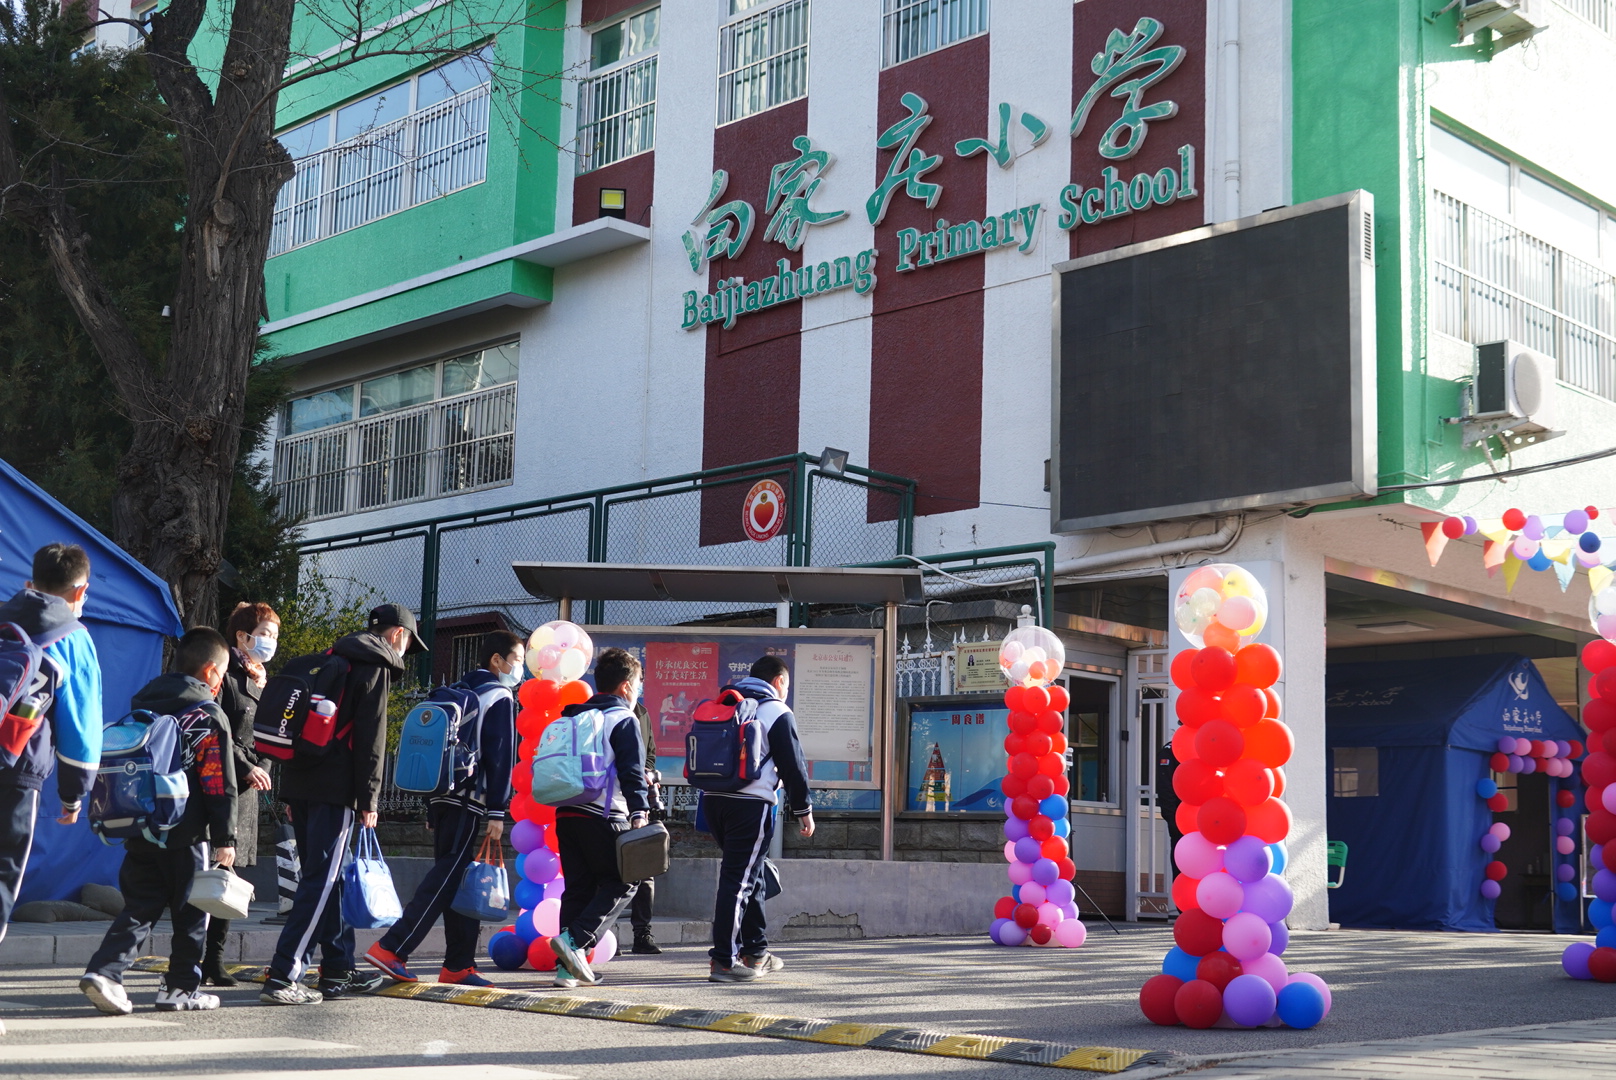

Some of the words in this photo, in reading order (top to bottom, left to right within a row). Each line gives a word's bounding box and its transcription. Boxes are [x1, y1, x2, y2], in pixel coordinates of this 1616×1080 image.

[681, 16, 1188, 275] 白家庄小学
[681, 247, 879, 331] Baijiazhuang
[895, 201, 1045, 273] Primary
[1057, 143, 1199, 232] School
[655, 659, 708, 670] 传承优良文化
[655, 670, 708, 680] 为了美好生活
[940, 713, 985, 725] 一周食谱
